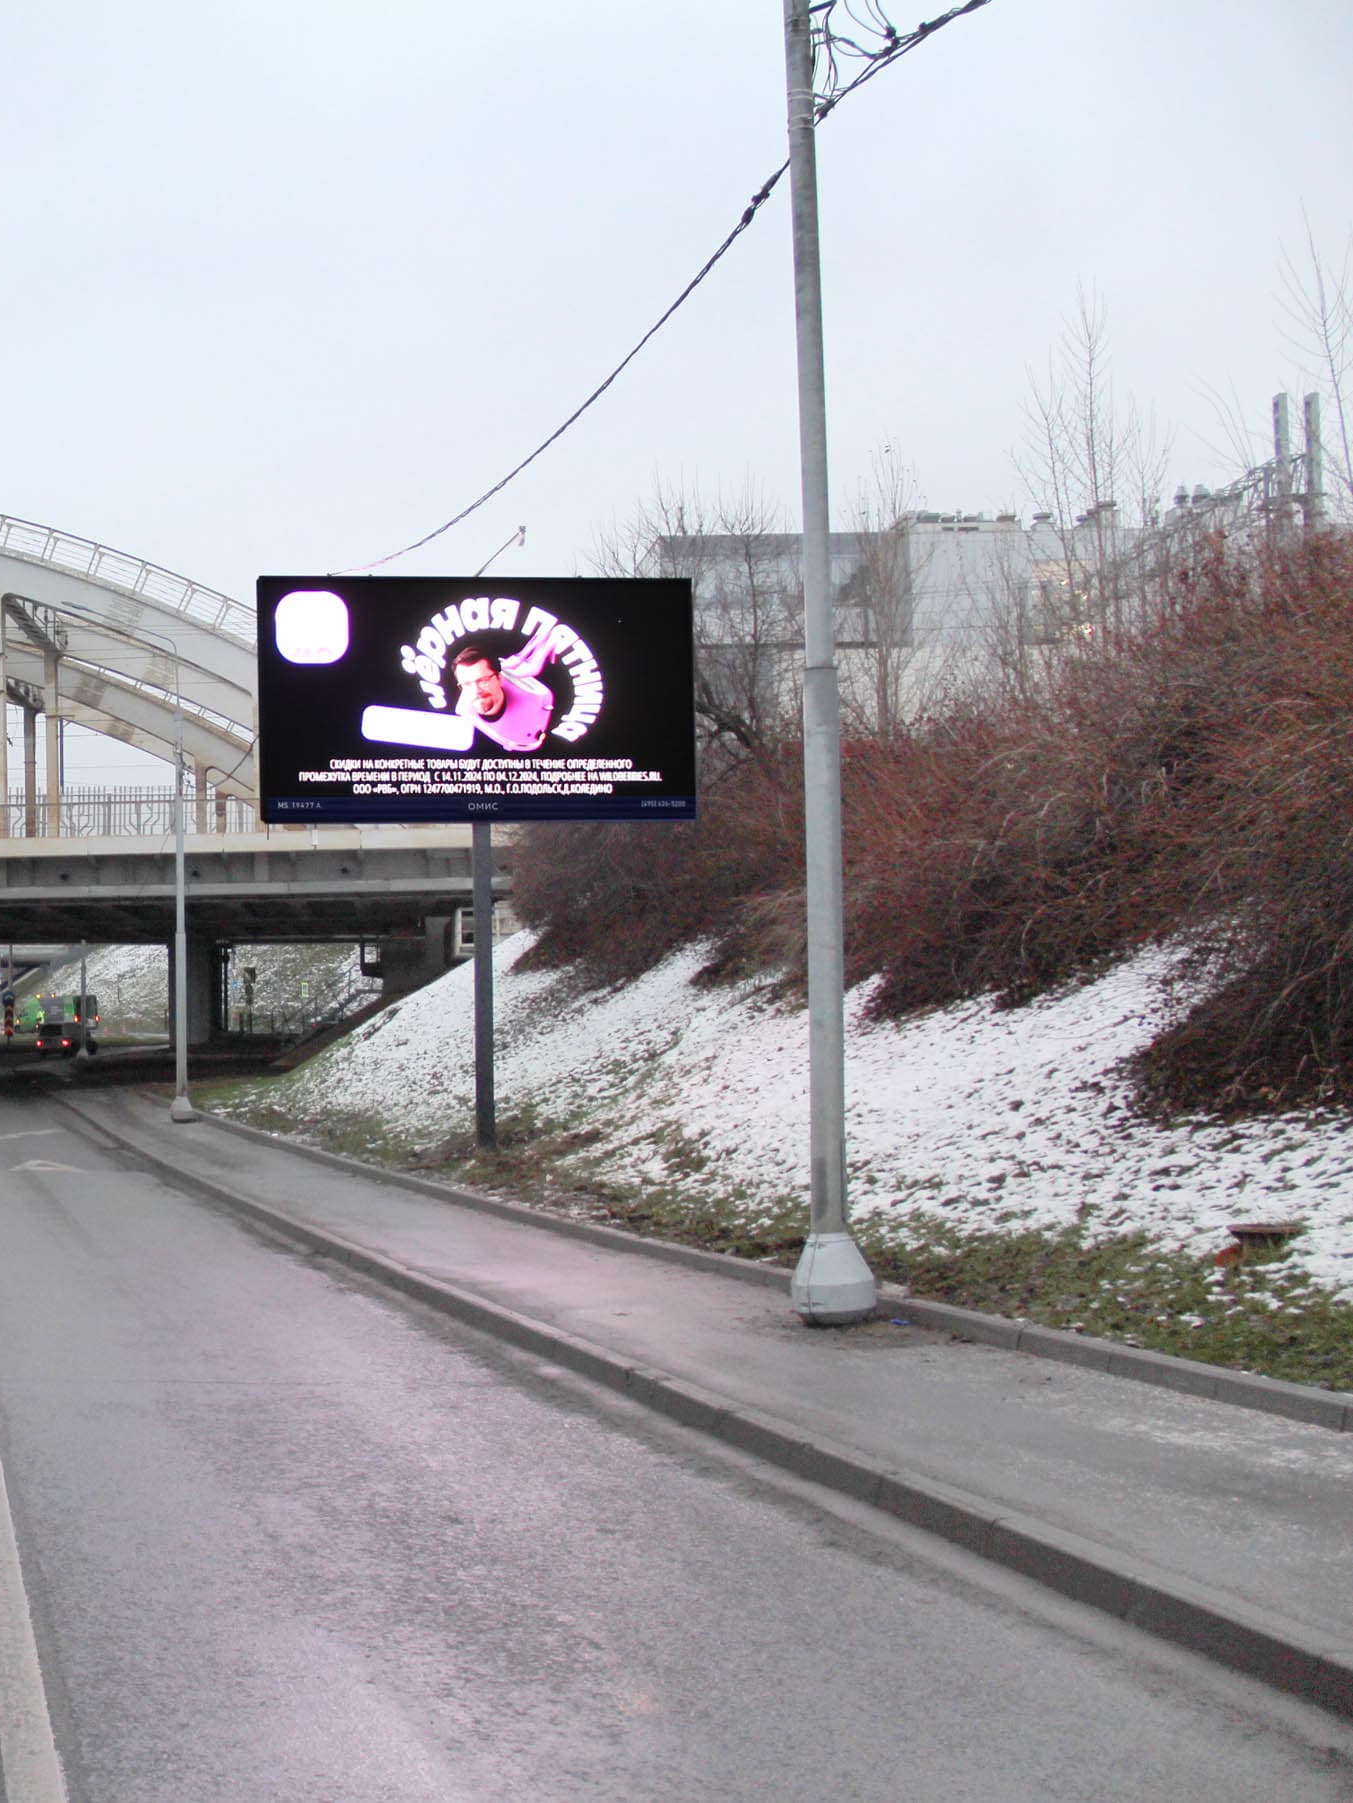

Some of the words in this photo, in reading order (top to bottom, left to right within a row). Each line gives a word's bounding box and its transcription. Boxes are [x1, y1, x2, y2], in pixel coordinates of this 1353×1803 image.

[329, 758, 362, 771] СКИДКИ
[362, 759, 373, 770] НА
[375, 759, 425, 770] КОНКРЕТНЫЕ
[426, 759, 459, 770] ТОВАРЫ
[459, 759, 481, 771] БУДУТ
[481, 759, 524, 771] ДОСТУПНЫ
[524, 759, 531, 770] В
[531, 759, 566, 770] ТЕЧЕНИЕ
[566, 759, 633, 771] ОПРЕДЕЛЕННОГО
[298, 771, 351, 782] ПРОМЕЖУТКА
[351, 771, 390, 782] ВРЕМЕНИ
[391, 771, 398, 782] В
[398, 771, 431, 783] ПЕРИОД
[434, 771, 441, 782] С
[442, 771, 482, 782] 14.11.2024
[483, 771, 496, 782] ПО
[540, 771, 586, 783] ПОДРОБНЕЕ
[587, 771, 599, 782] НА
[353, 783, 372, 795] ООО
[400, 783, 422, 795] ОГРН
[467, 802, 499, 811] ОМИС
